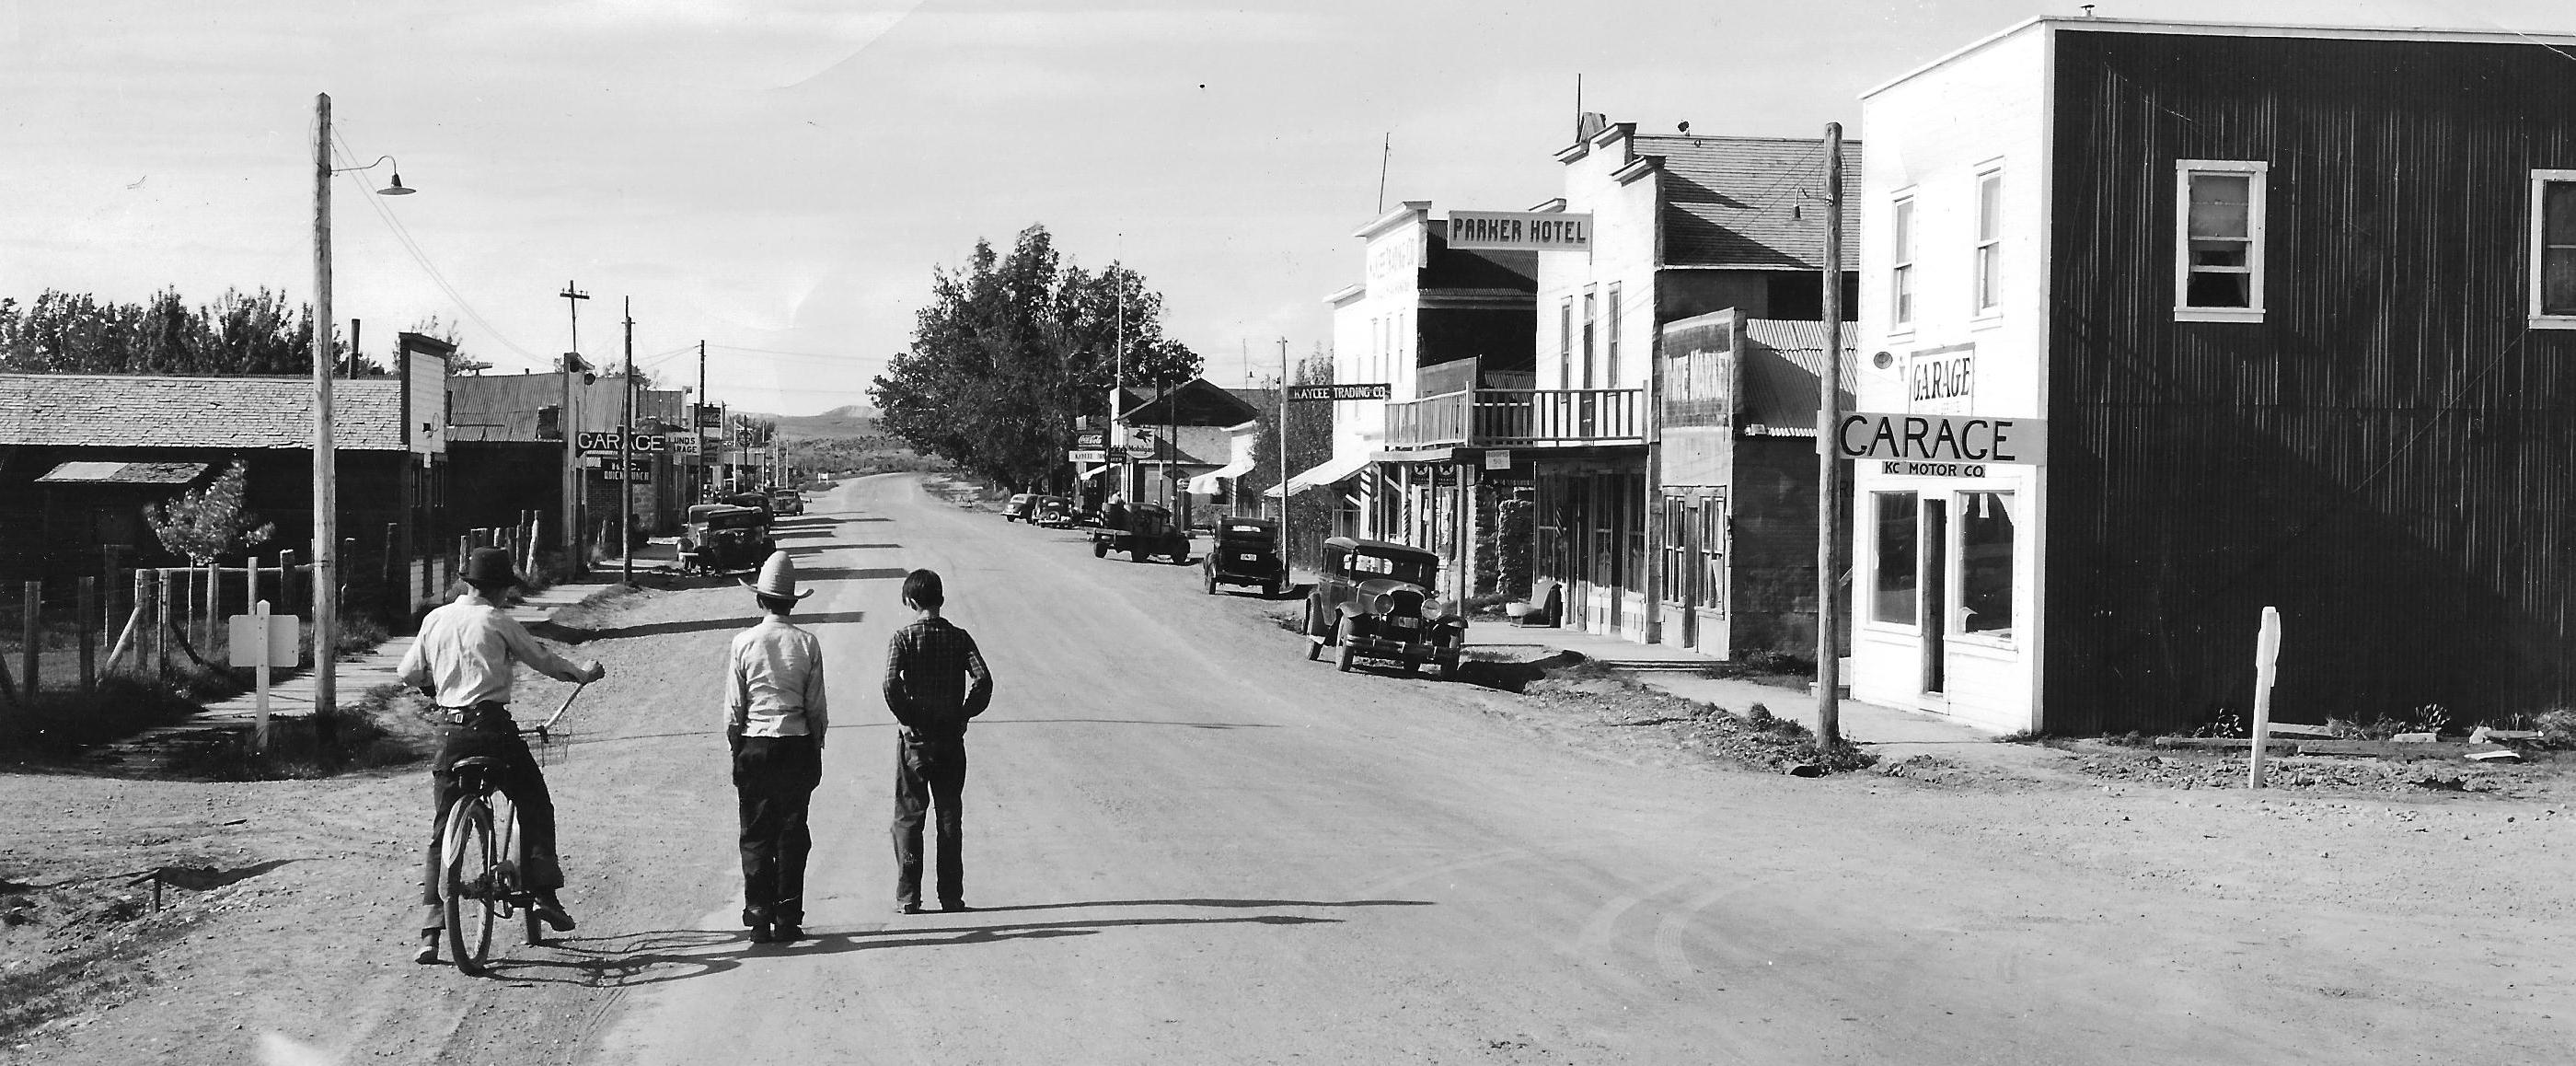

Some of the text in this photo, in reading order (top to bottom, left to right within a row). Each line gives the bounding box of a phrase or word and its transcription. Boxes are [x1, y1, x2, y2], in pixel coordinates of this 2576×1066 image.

[1453, 218, 1586, 243] PARKER HOTEL
[1913, 357, 1970, 401] GARAGE
[1294, 388, 1330, 399] KAYCEE
[1333, 387, 1369, 399] TRADING
[1841, 415, 2016, 461] GARAGE
[673, 446, 698, 454] RAGE
[630, 471, 650, 481] UNCH
[1884, 461, 1900, 474] KC
[1909, 462, 1958, 477] MOTOR
